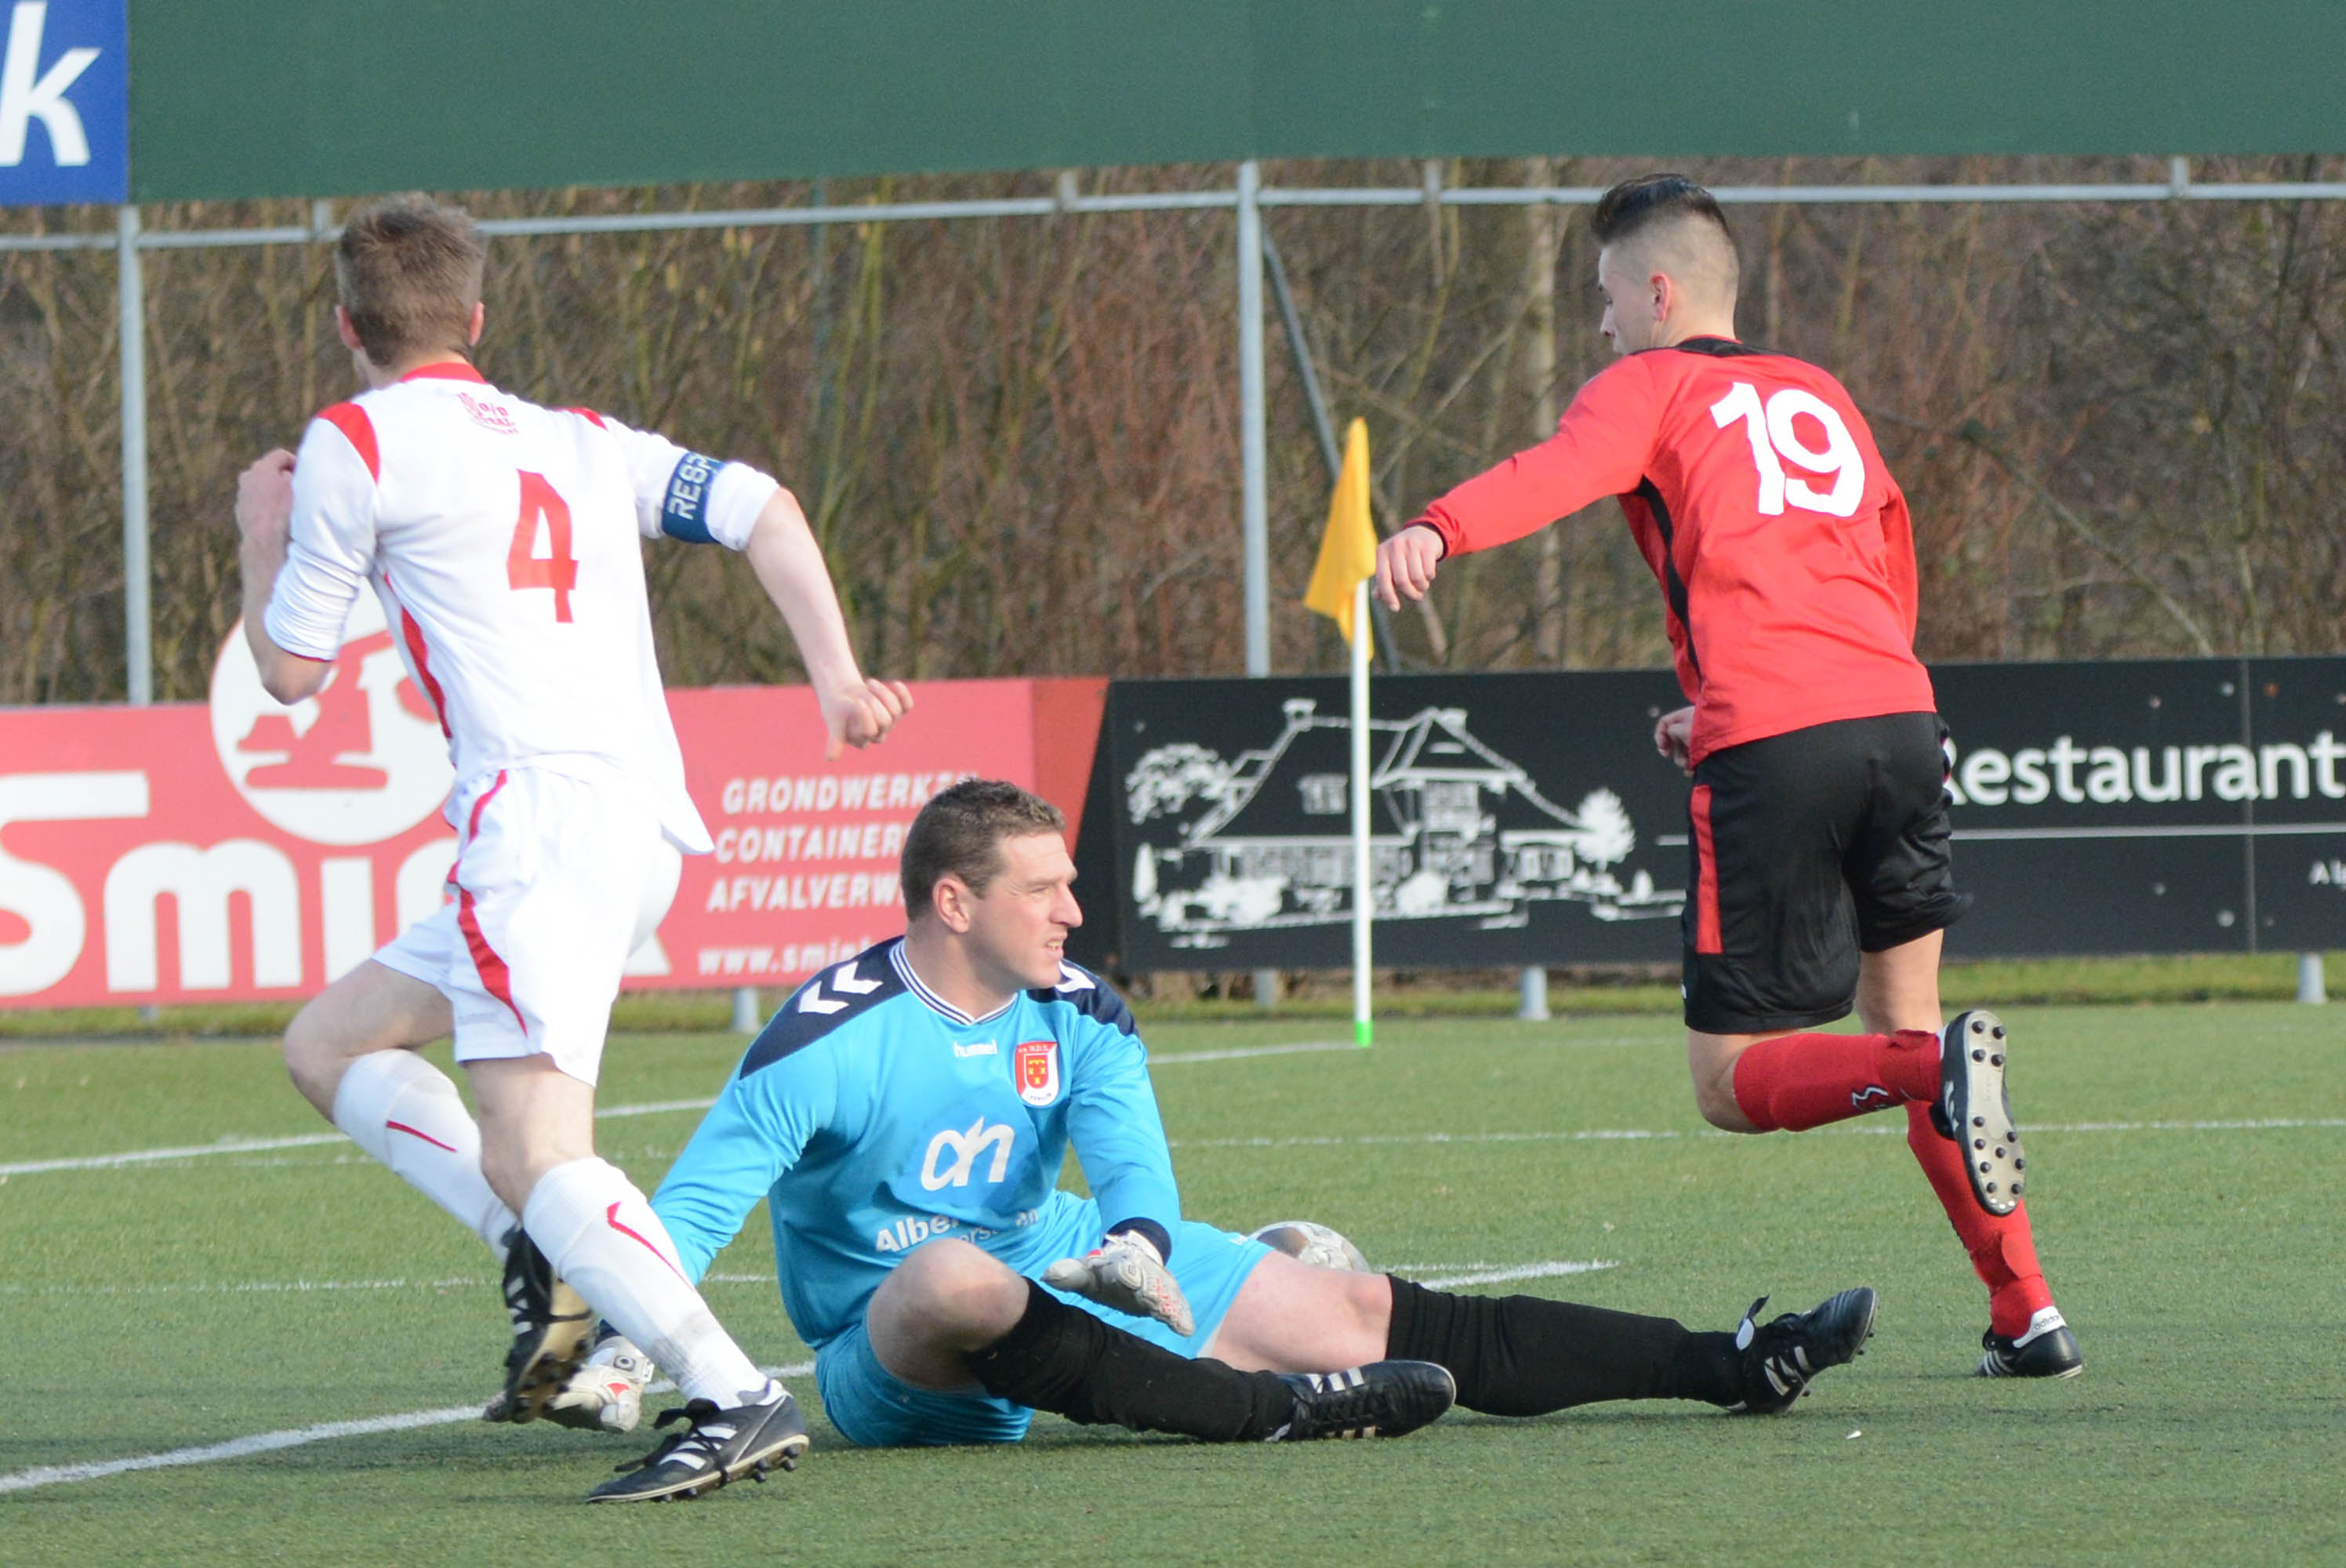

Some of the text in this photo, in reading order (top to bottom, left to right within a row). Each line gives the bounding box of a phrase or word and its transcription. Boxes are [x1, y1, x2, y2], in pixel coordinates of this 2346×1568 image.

[1709, 382, 1865, 517] 19
[507, 468, 579, 623] 4
[715, 822, 913, 863] CONTAINER
[705, 872, 906, 913] AFVALVERW
